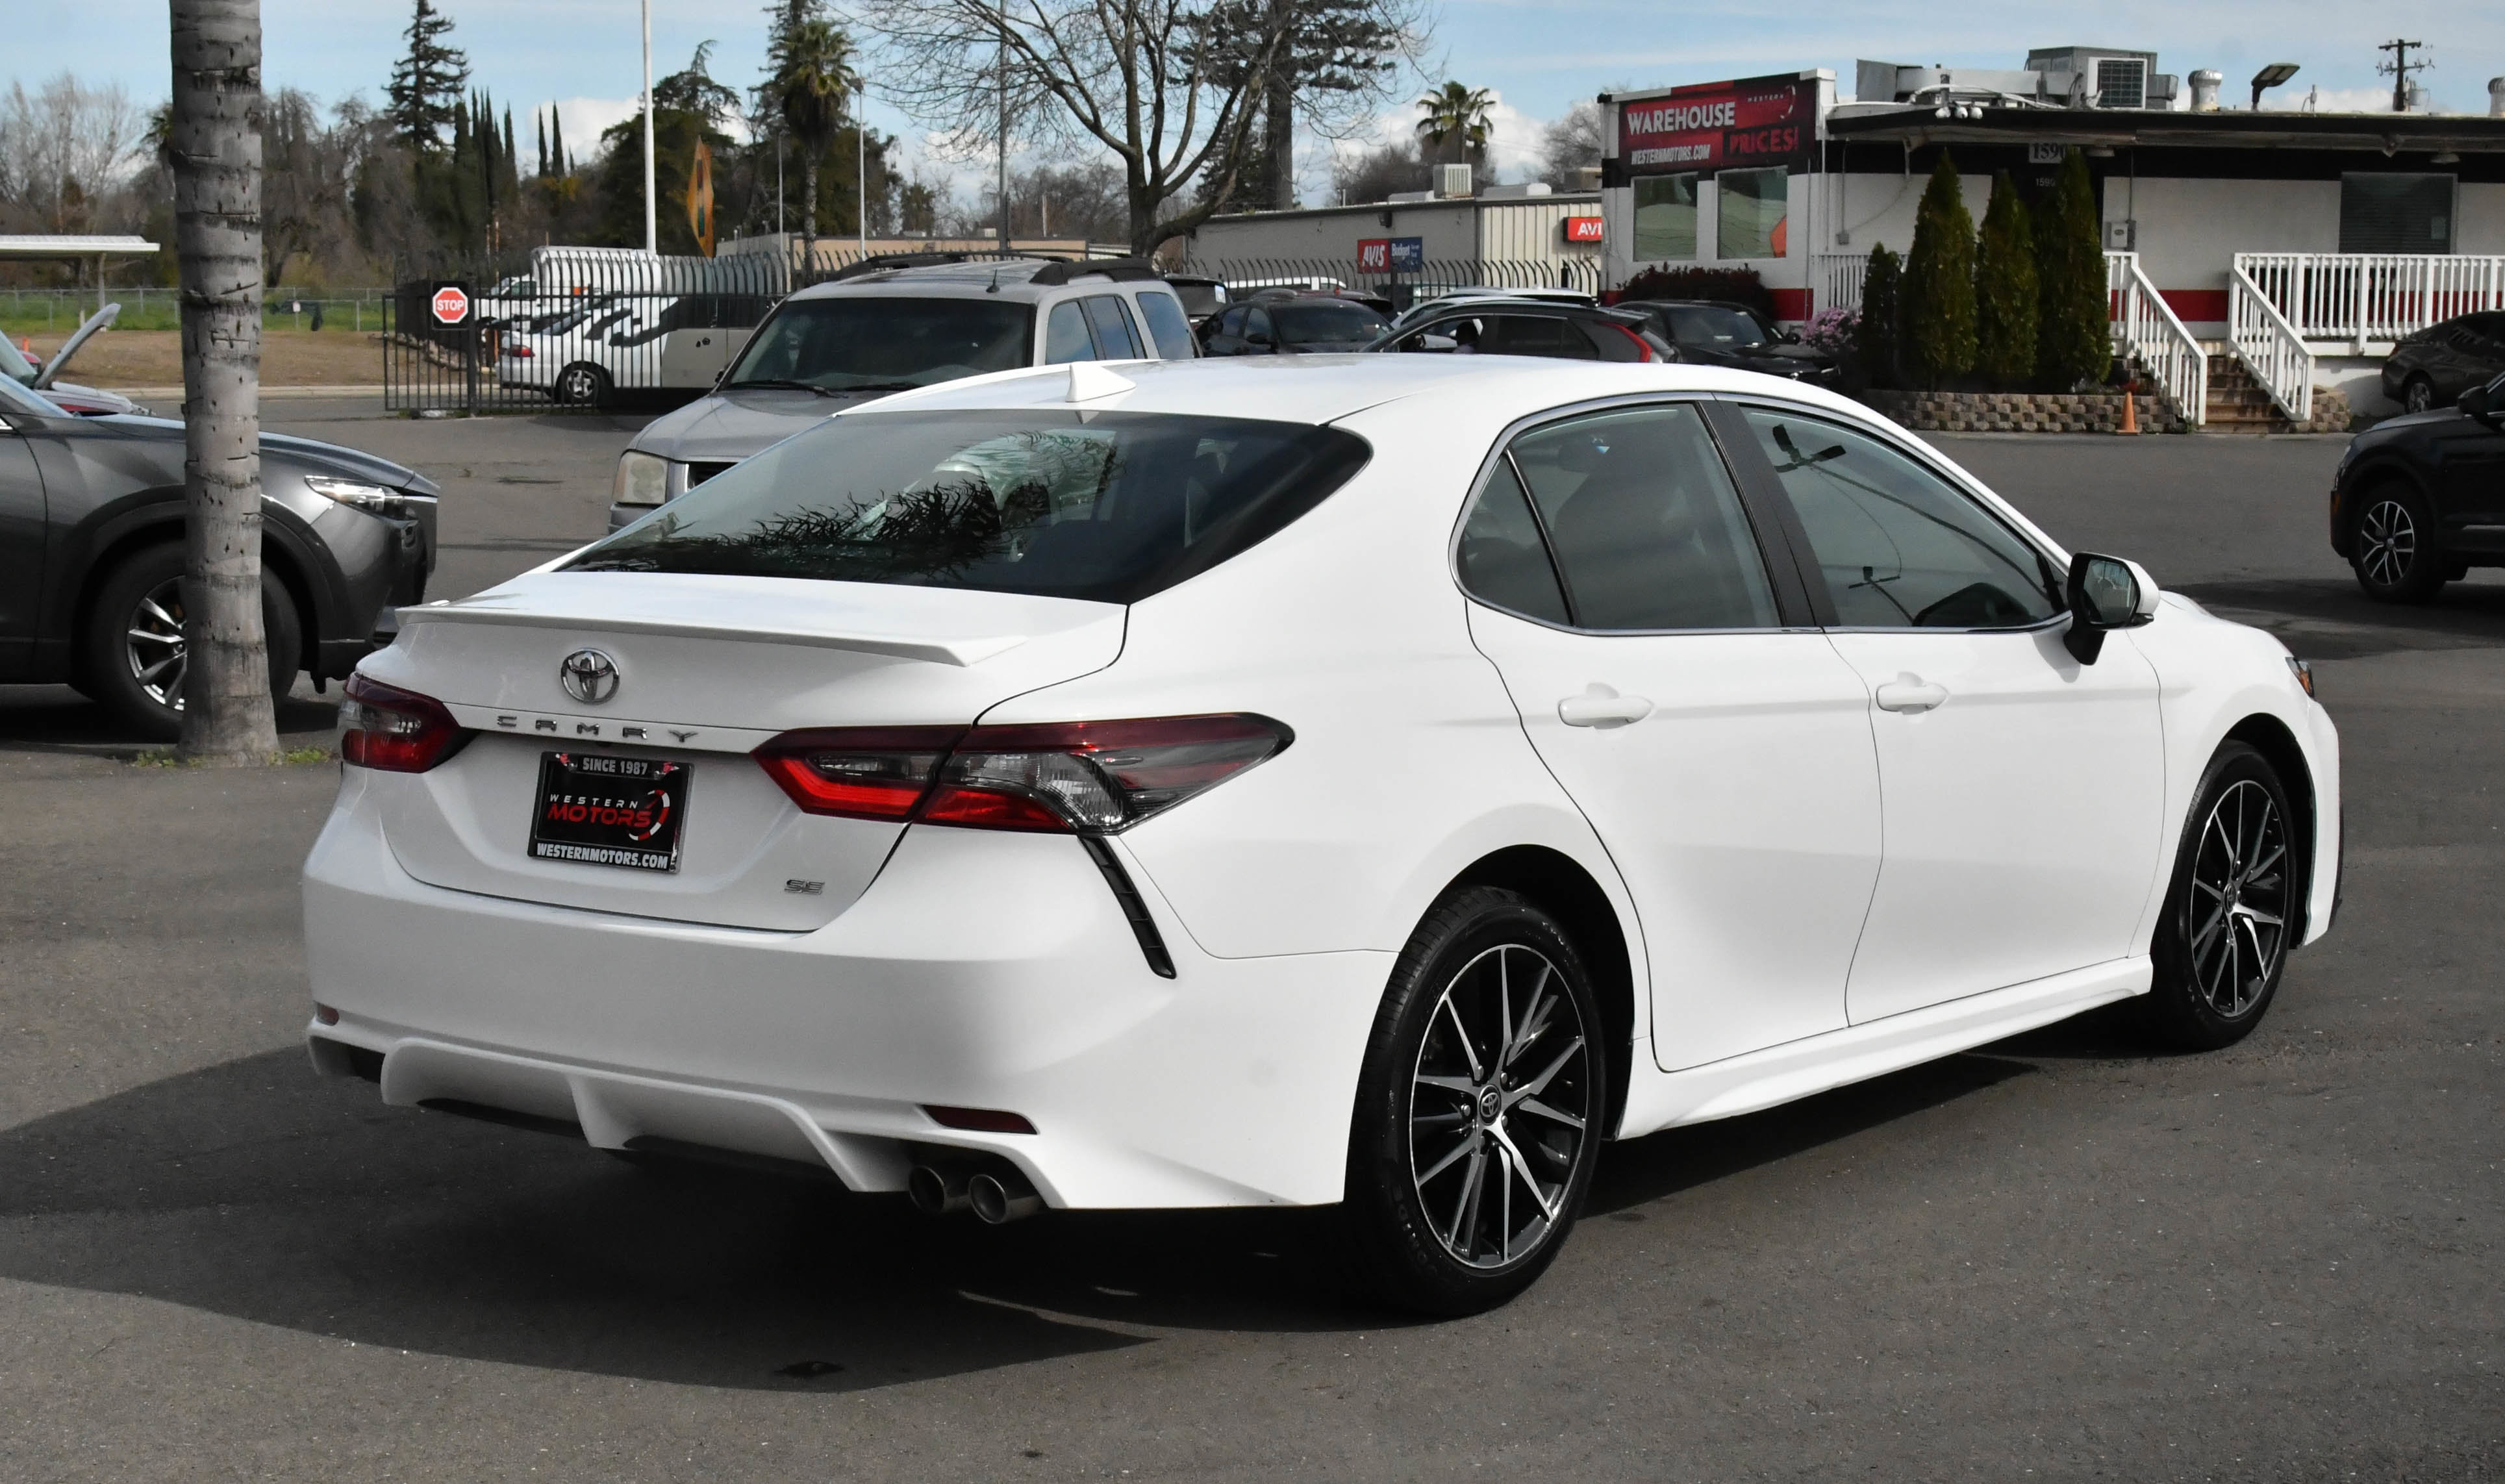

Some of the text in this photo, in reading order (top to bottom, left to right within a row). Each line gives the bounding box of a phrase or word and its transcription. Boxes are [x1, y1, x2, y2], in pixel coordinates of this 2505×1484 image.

[1627, 101, 1735, 135] WAREHOUSE
[1730, 125, 1798, 154] PRICES!
[1631, 144, 1711, 166] WESTERNMOTORS.COM
[1362, 244, 1385, 267] AVIS
[436, 299, 464, 311] STOP
[497, 716, 698, 742] CAMRY
[583, 758, 648, 775] SINCE 1987
[550, 794, 638, 809] WESTERN
[547, 803, 652, 828] MOTORS
[537, 843, 668, 869] WESTERNMOTORS.COM
[784, 879, 825, 895] SE
